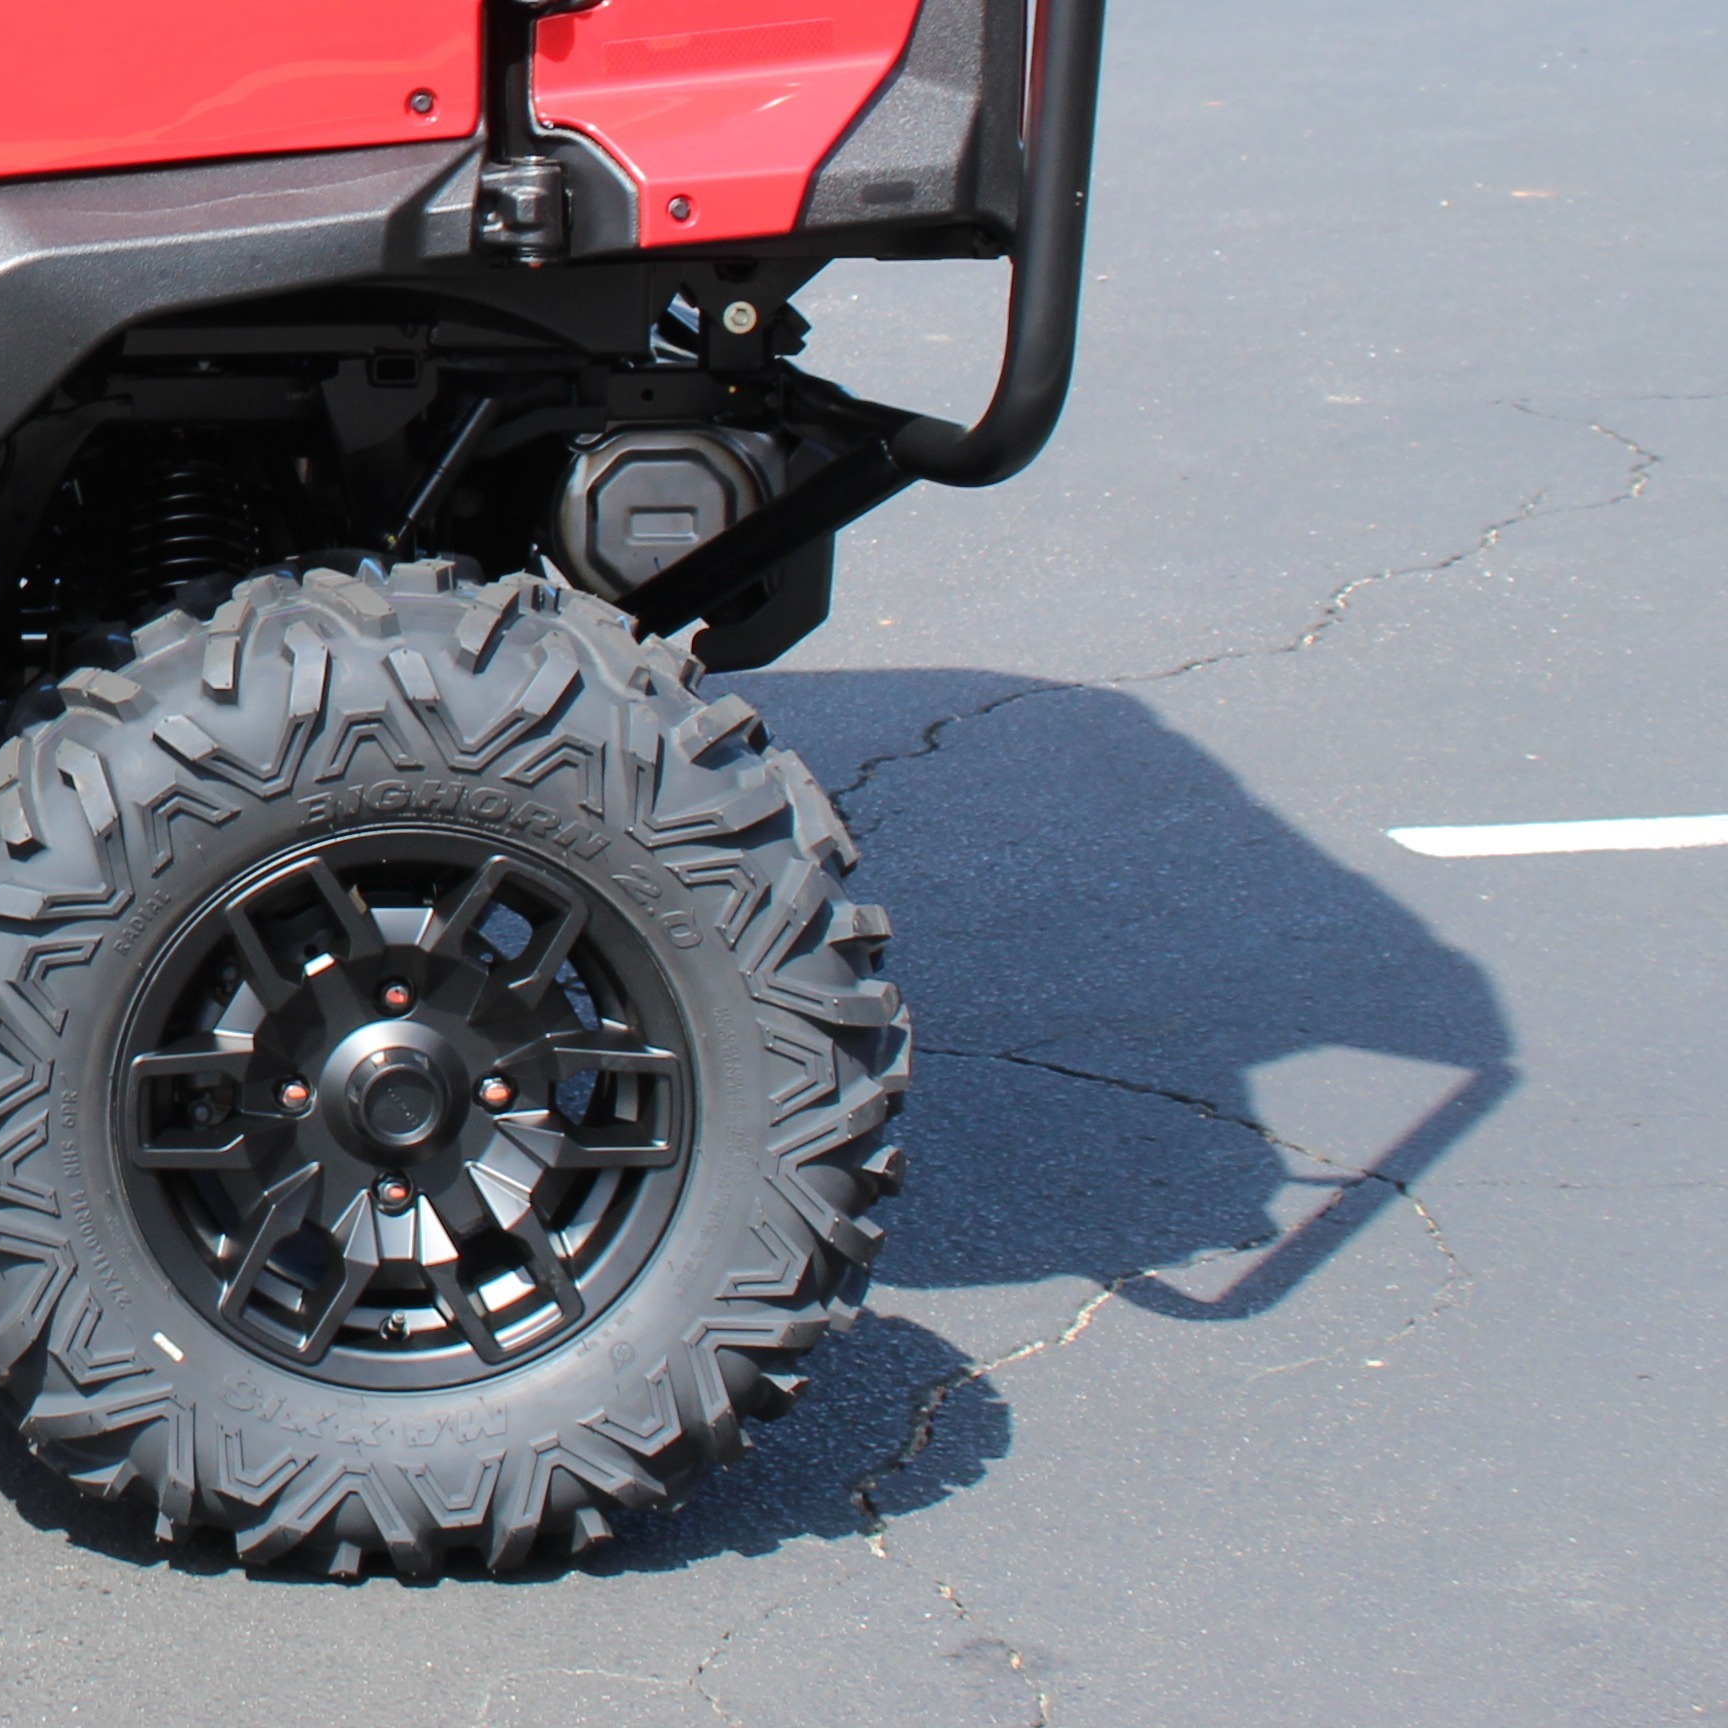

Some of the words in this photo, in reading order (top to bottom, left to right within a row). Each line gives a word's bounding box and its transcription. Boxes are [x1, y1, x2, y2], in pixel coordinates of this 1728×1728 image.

[296, 778, 611, 862] BIGHORN
[612, 863, 704, 950] 2.0
[112, 888, 173, 957] RADIAL
[60, 1090, 79, 1129] 6PR
[60, 1139, 82, 1179] NHS
[214, 1372, 509, 1448] MAXXIS
